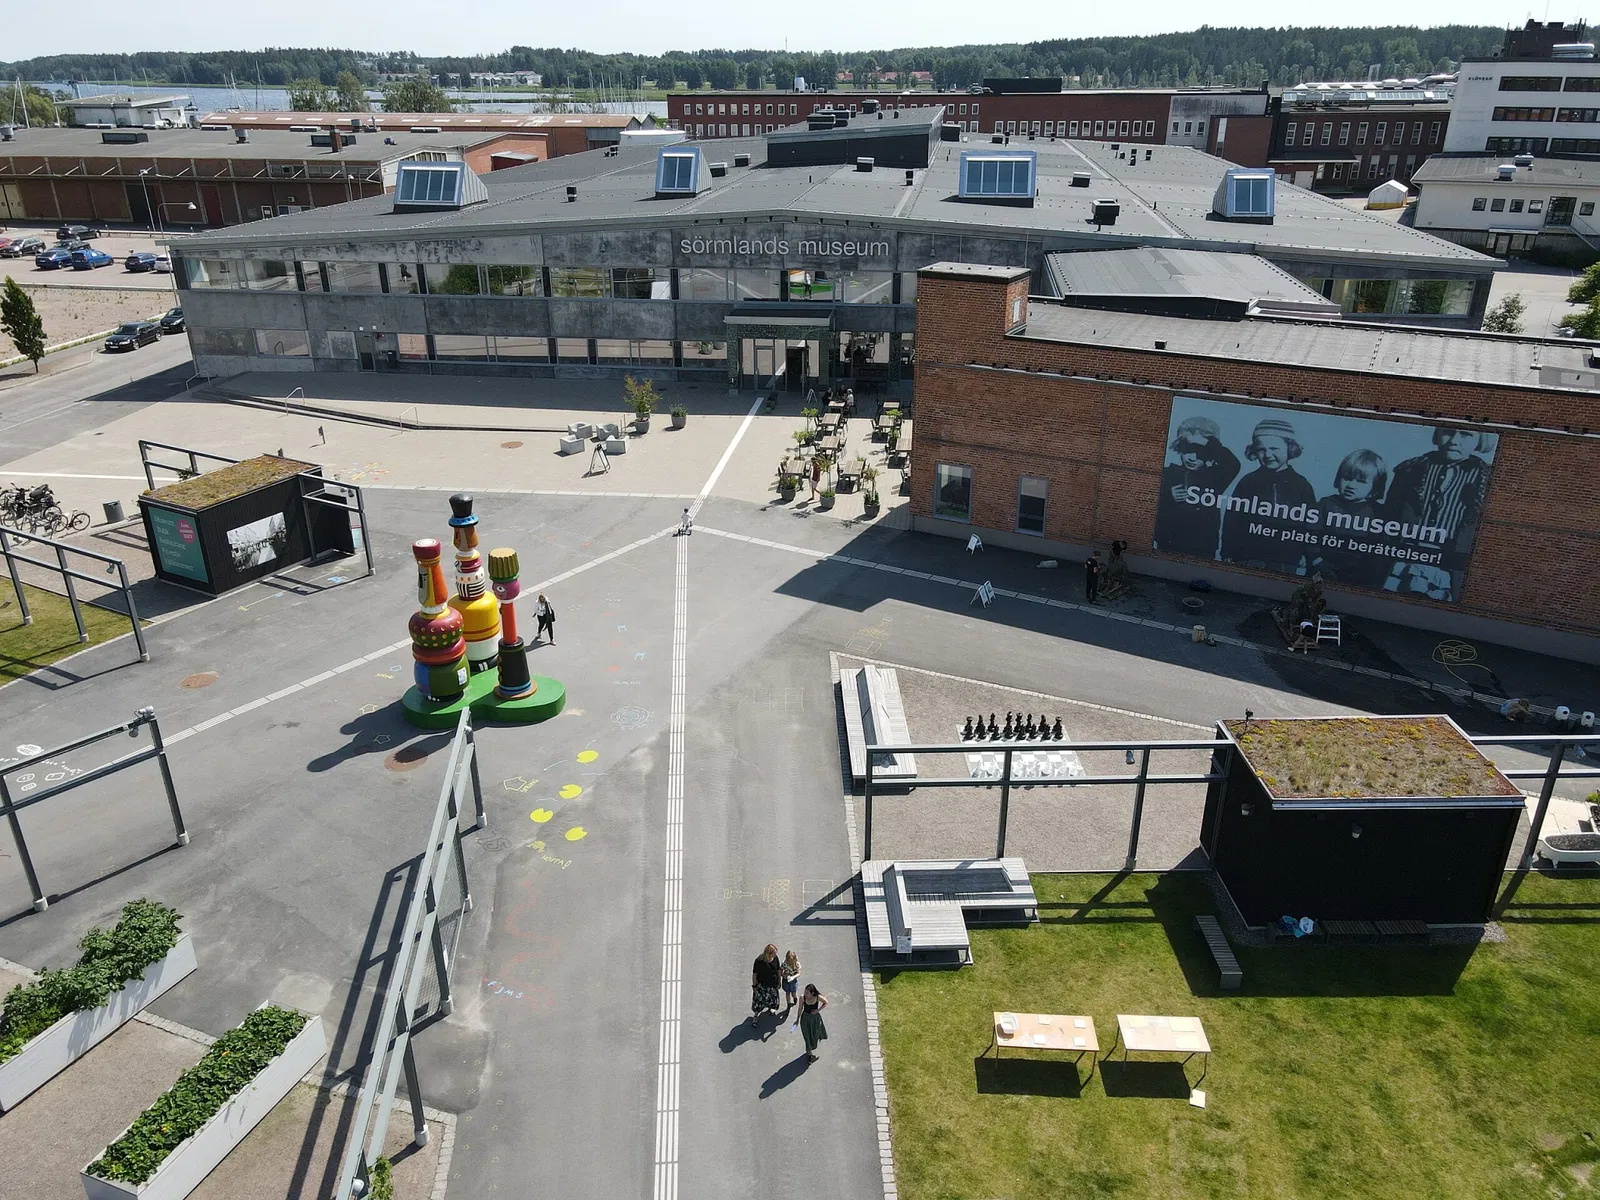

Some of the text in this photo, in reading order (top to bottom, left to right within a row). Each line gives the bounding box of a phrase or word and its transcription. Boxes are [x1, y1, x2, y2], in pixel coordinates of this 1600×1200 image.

[680, 235, 889, 256] sörmlands museum
[1185, 485, 1448, 544] Sörmlands museum
[1249, 522, 1442, 565] Mer plats för berättelser!
